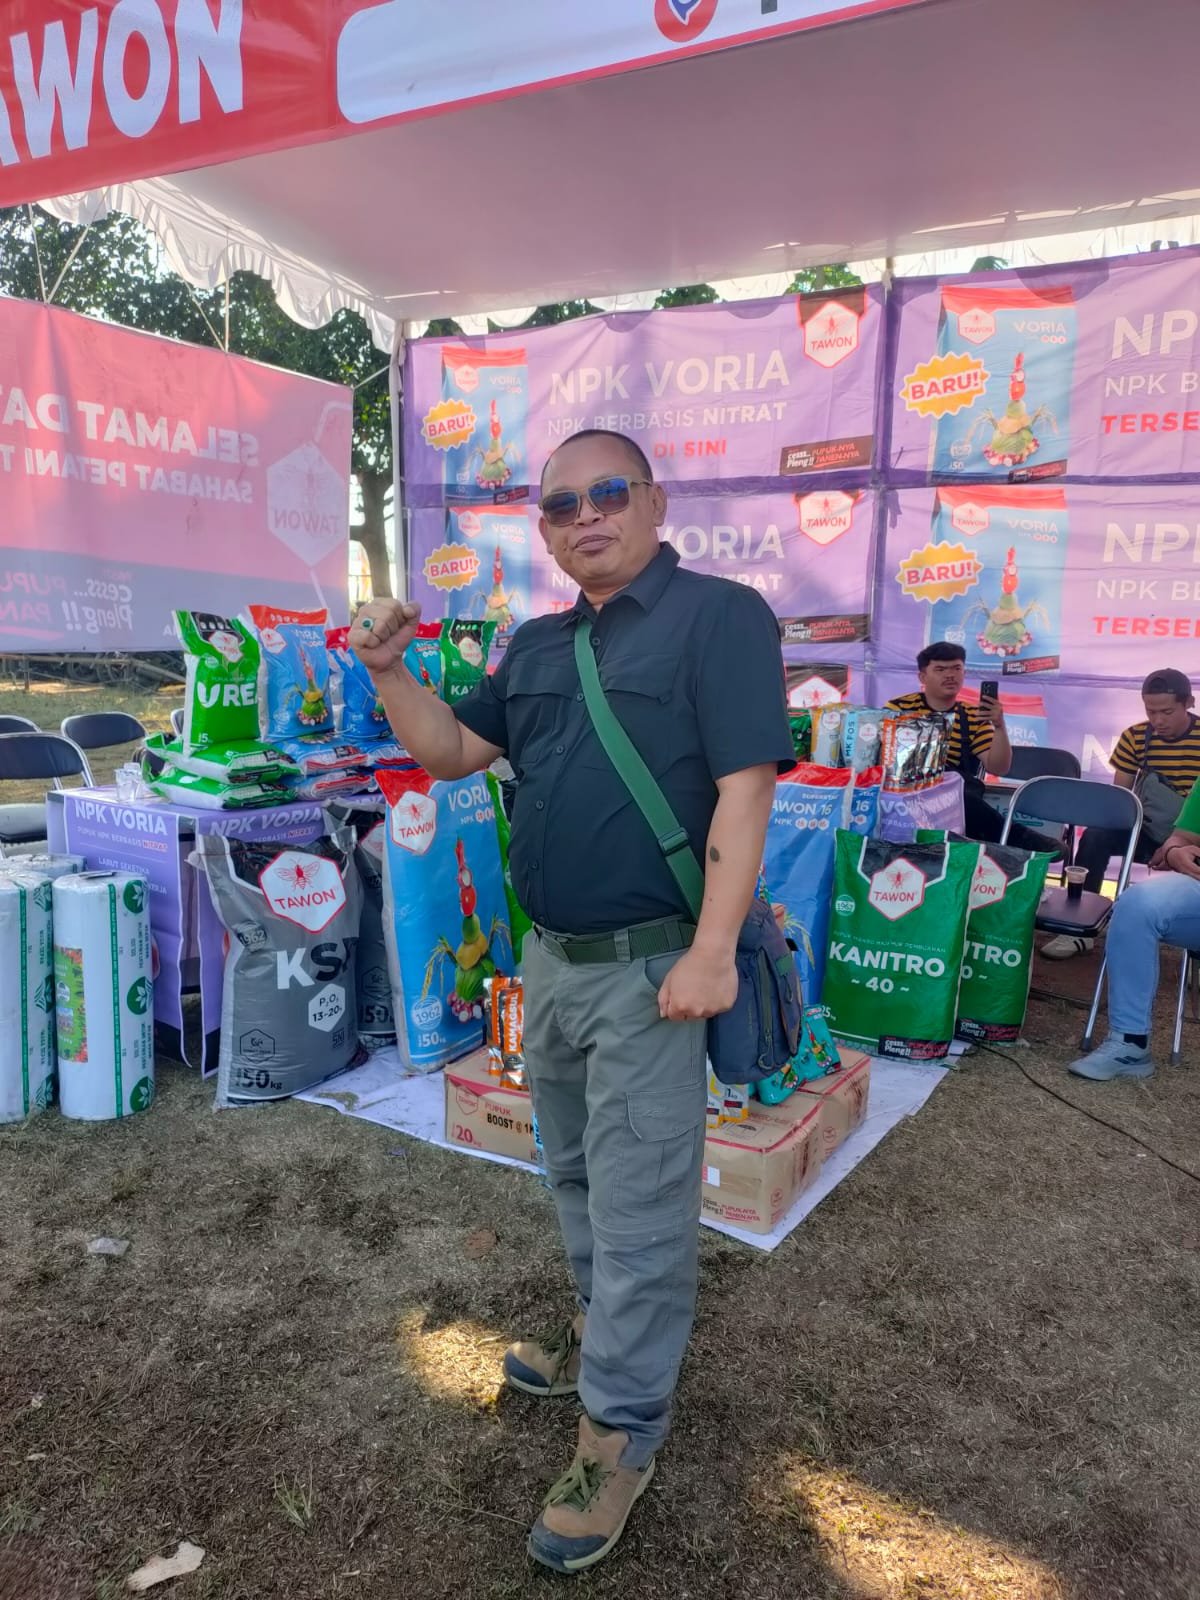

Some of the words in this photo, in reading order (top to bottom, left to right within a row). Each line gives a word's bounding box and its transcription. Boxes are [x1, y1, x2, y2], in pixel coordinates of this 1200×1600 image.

[1013, 320, 1066, 334] VORIA
[811, 336, 853, 350] TAWON
[550, 364, 630, 406] NPK
[644, 350, 790, 397] VORIA
[910, 372, 980, 401] BARU!
[1105, 373, 1168, 397] NPK
[427, 415, 472, 437] BARU!
[548, 418, 585, 436] NPK
[593, 409, 694, 432] BERBASIS
[703, 402, 787, 426] NITRAT
[1101, 411, 1200, 434] TERSE
[653, 442, 674, 459] DI
[684, 440, 727, 457] SINI
[806, 517, 847, 528] TAWON
[1103, 522, 1200, 563] NP
[429, 558, 474, 577] BARU!
[906, 561, 973, 587] BARU!
[1097, 580, 1158, 600] NPK
[197, 682, 258, 708] URE
[451, 685, 474, 696] KA
[847, 721, 855, 740] FOS
[845, 743, 852, 756] MK
[820, 803, 833, 816] 16
[856, 800, 869, 812] 16
[75, 799, 107, 824] NPK
[110, 807, 168, 836] VORIA
[210, 816, 256, 836] NPK
[261, 807, 322, 830] VORIA
[399, 820, 434, 839] TAWON
[274, 889, 336, 910] TAWON
[874, 892, 915, 902] TAWON
[829, 941, 945, 977] KANITRO
[416, 1006, 440, 1023] 1962
[509, 993, 518, 1052] KAMAGSUL
[422, 1032, 439, 1048] 50
[271, 1081, 282, 1090] kg
[487, 1113, 513, 1129] BOOST
[456, 1124, 473, 1144] 20
